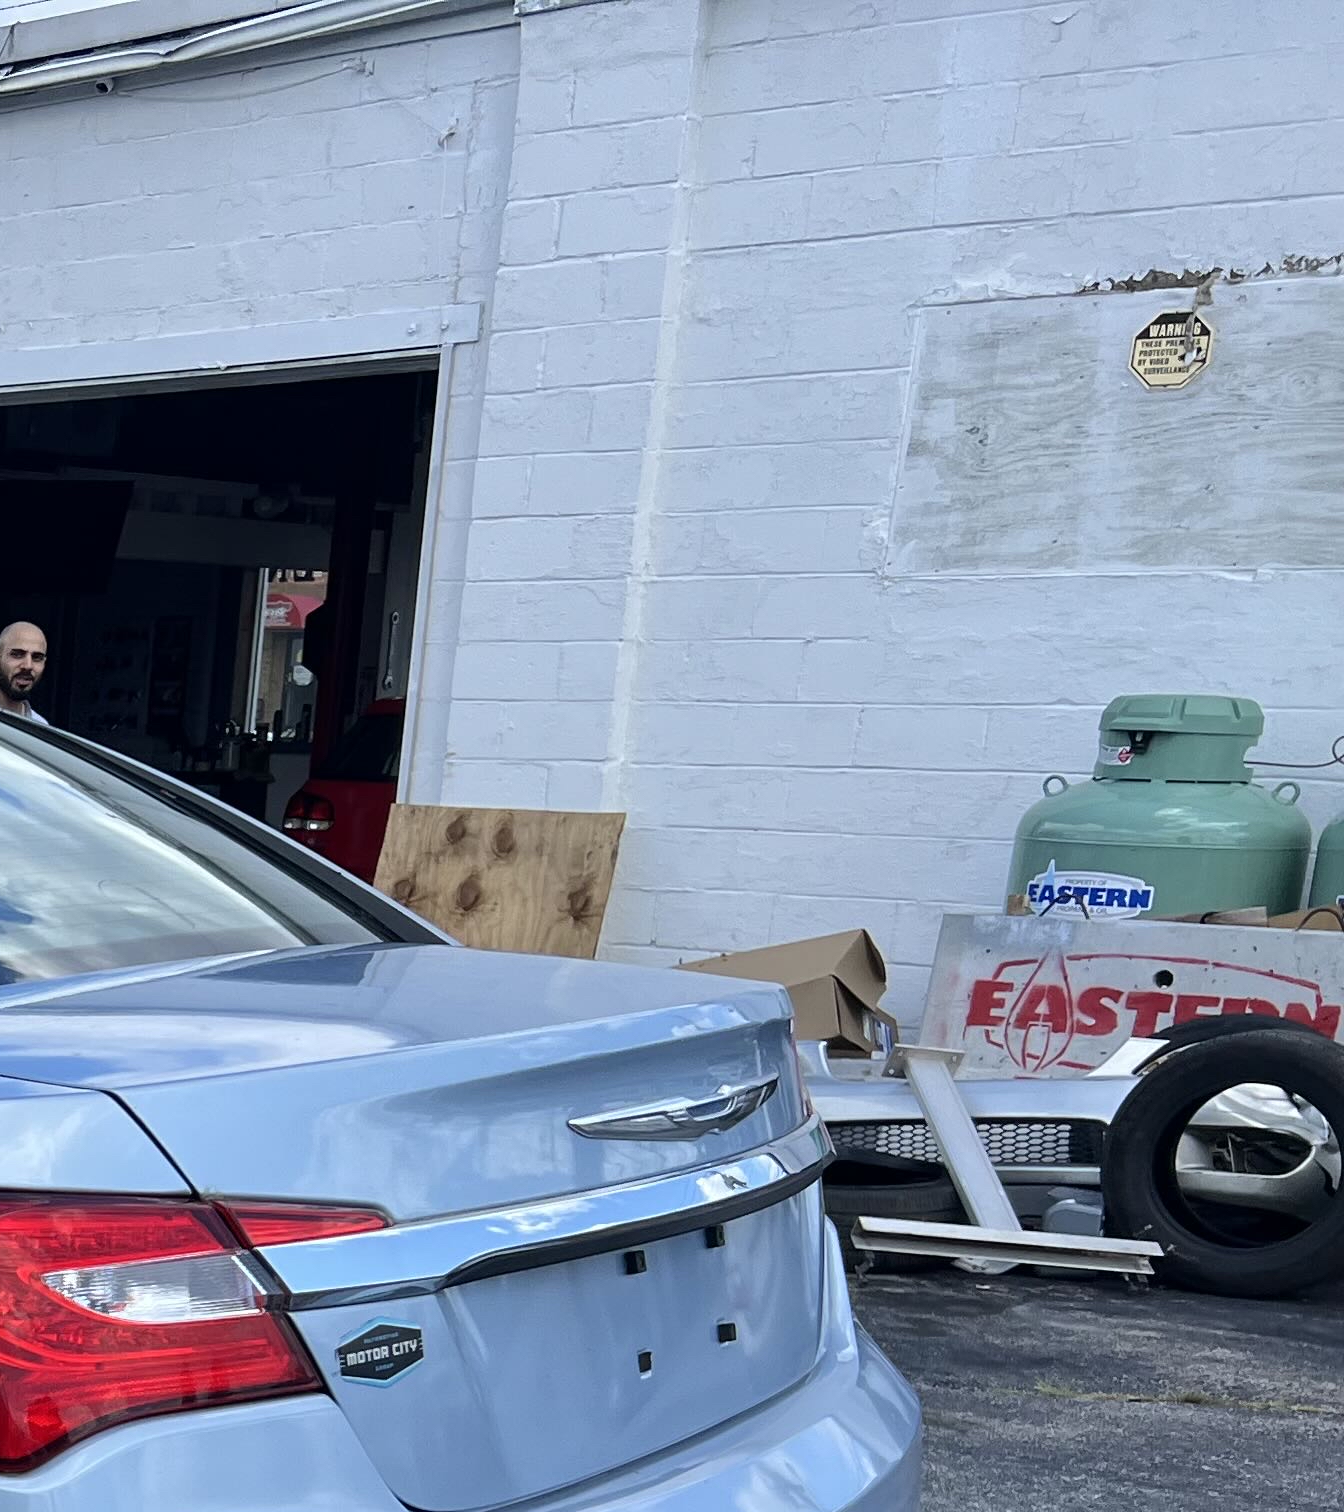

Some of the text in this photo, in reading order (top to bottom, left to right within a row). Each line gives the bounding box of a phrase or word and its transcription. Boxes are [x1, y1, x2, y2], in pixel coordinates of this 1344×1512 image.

[1150, 322, 1201, 336] WARNIG
[1166, 339, 1201, 347] PREMS
[1029, 884, 1151, 907] EASTERN
[1056, 905, 1087, 913] PROPAN
[347, 1339, 418, 1366] MOTOR CITY
